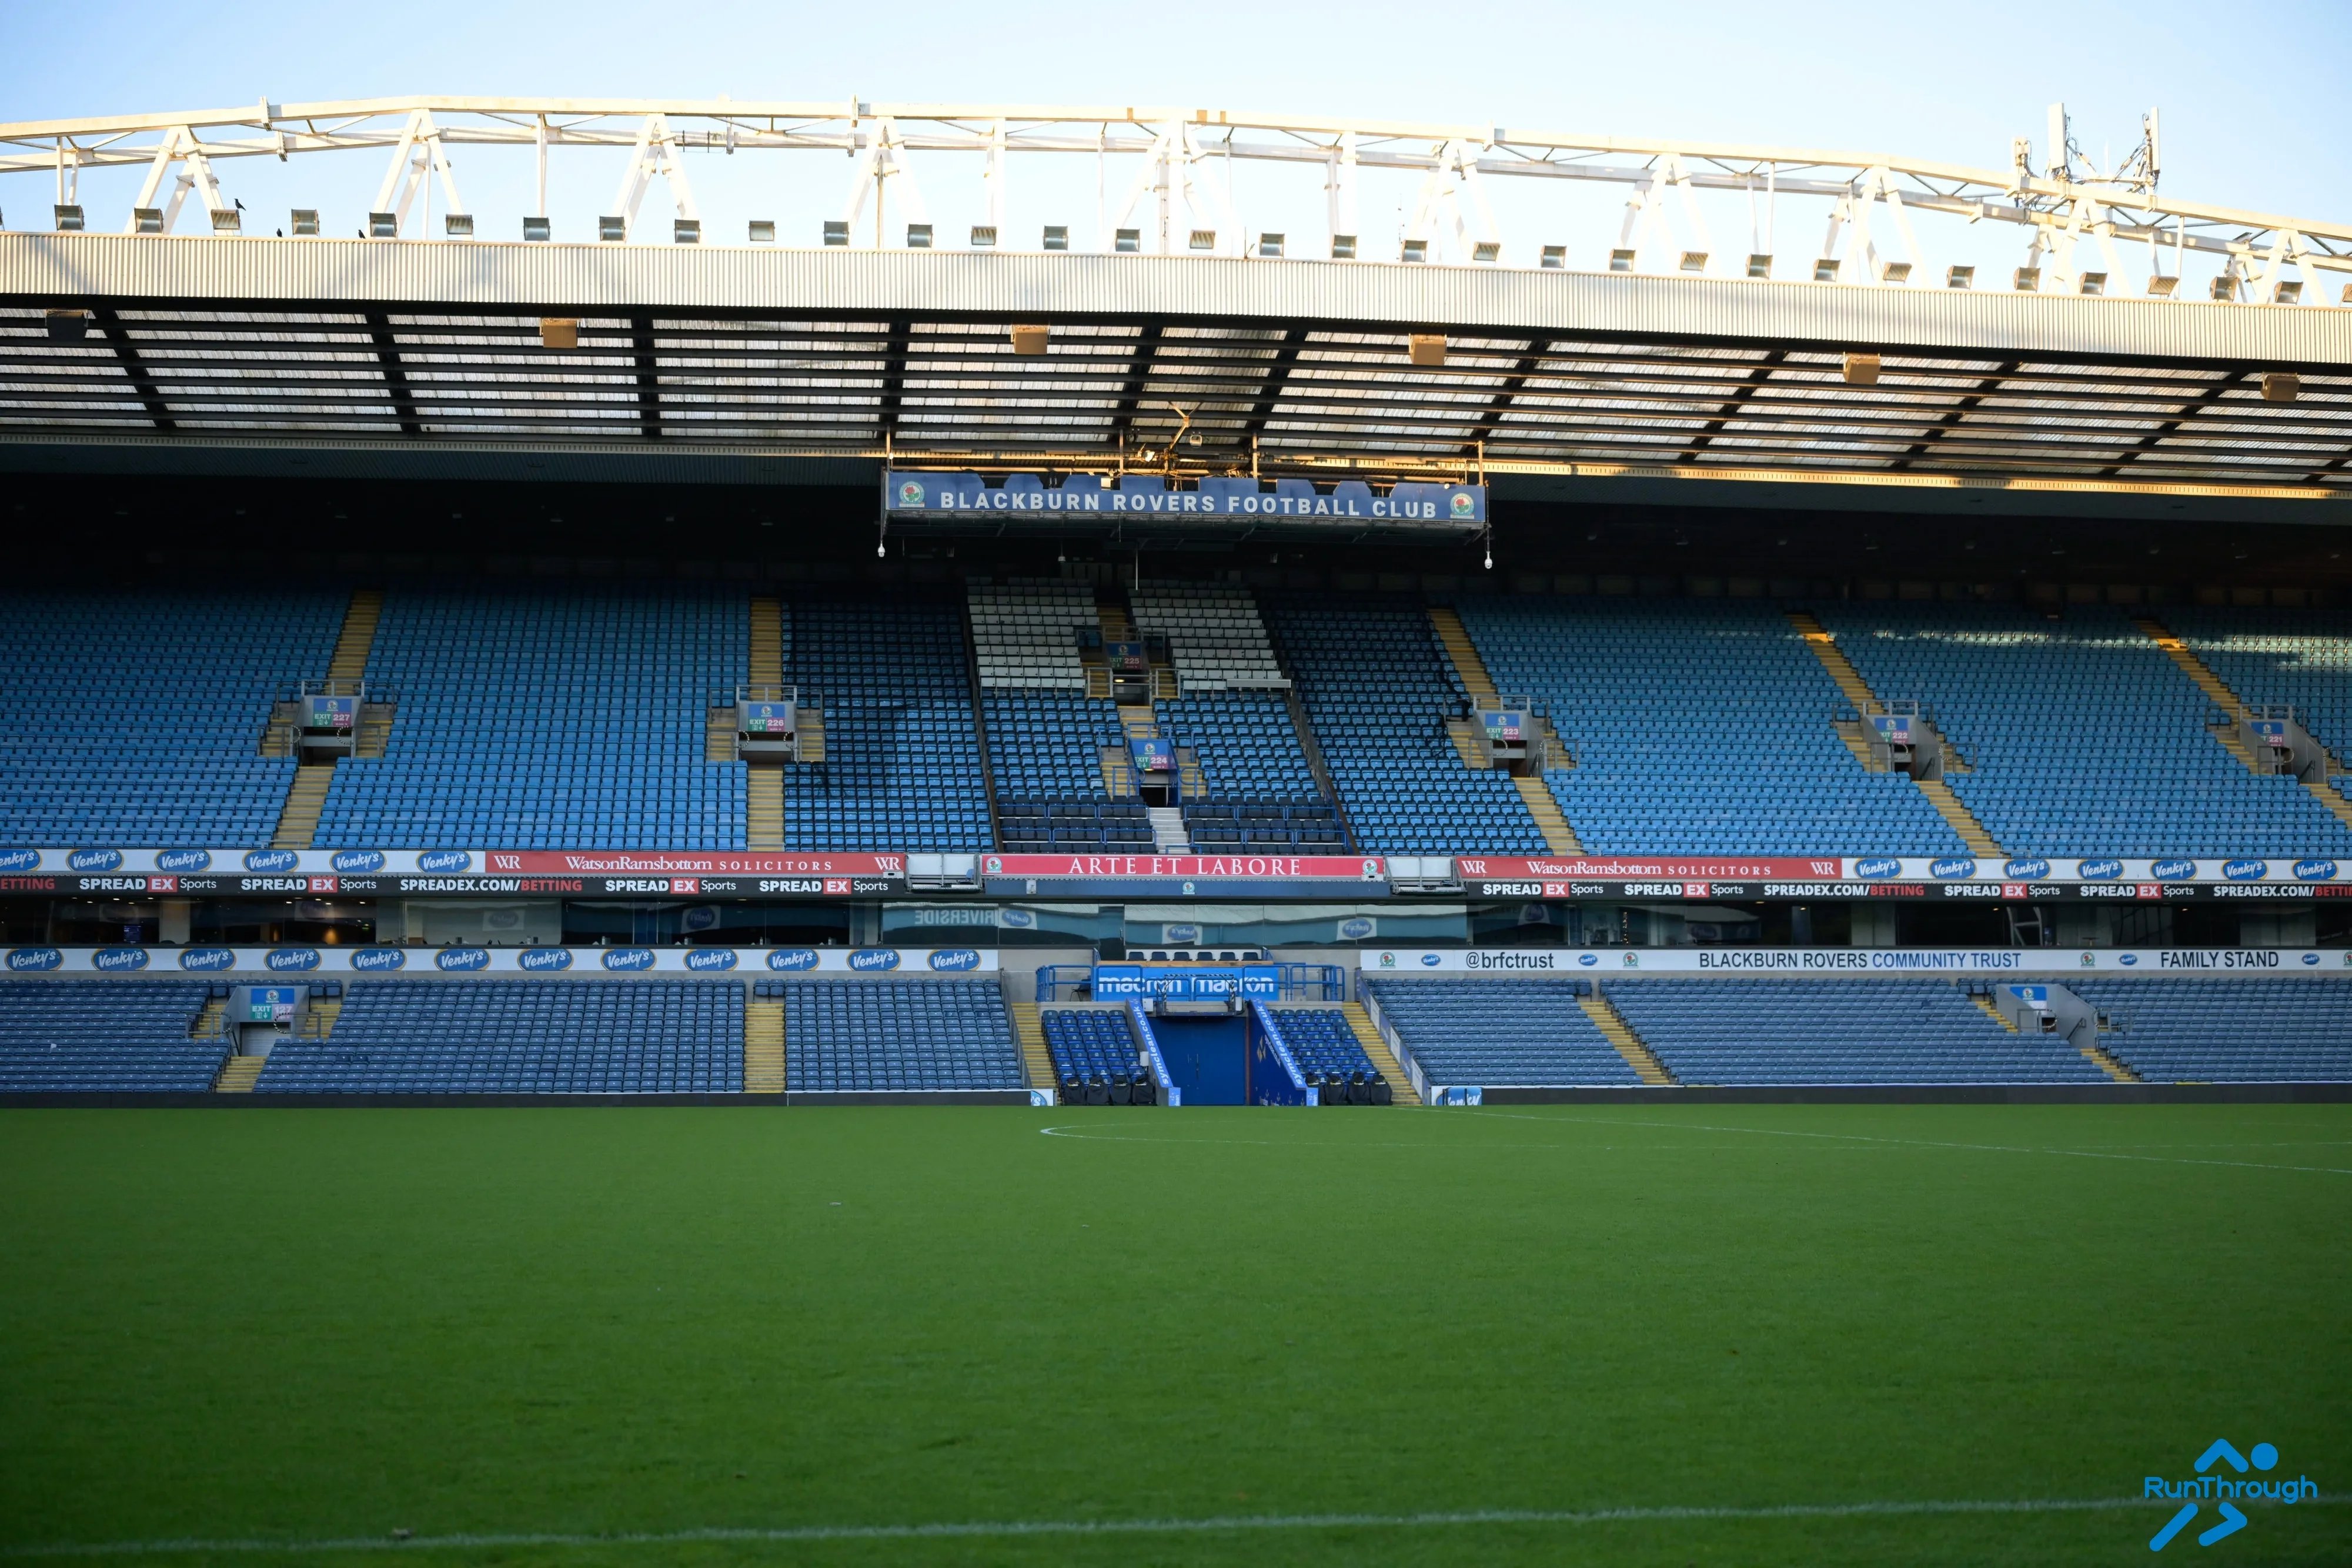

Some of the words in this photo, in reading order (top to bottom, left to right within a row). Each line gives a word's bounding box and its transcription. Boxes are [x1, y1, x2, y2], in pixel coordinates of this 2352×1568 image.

[941, 492, 1099, 510] BLACKBURN
[1113, 494, 1215, 512] ROVERS
[1228, 497, 1360, 516] FOOTBALL
[1372, 500, 1436, 519] CLUB
[0, 851, 35, 868] enky's
[74, 851, 116, 868] Venky's
[162, 851, 205, 868] Venky's
[249, 851, 292, 868] Venky's
[336, 851, 379, 869] Venky's
[423, 852, 465, 869] Venky's
[493, 855, 522, 869] WR
[565, 856, 712, 870] WatsonRamsbottom
[720, 861, 831, 871] SOLICITORS
[874, 857, 900, 870] WR
[1068, 857, 1137, 874] ARTE
[1151, 857, 1182, 874] ET
[1197, 858, 1301, 875] LABORE
[1462, 860, 1486, 874] WR
[1527, 861, 1662, 875] WatsonRamsbottom
[1668, 865, 1771, 875] SOLICITORS
[1810, 862, 1834, 875] WR
[1859, 861, 1896, 876] Venky's
[1935, 861, 1970, 876] Venky's
[2009, 861, 2044, 877] Venky's
[2083, 861, 2119, 877] Venky's
[2156, 861, 2191, 877] Venky's
[2227, 861, 2263, 877] Venky's
[2297, 861, 2332, 877] Venky's
[1, 878, 55, 890] ETTING
[181, 878, 216, 891] Sports
[340, 879, 376, 891] Sports
[701, 880, 736, 892] Sports
[854, 881, 888, 893] Sports
[1571, 884, 1603, 895] Sports
[1712, 884, 1743, 896] Sports
[2029, 885, 2060, 897] Sports
[2163, 885, 2194, 897] Sports
[13, 952, 55, 967] Venky's
[99, 952, 142, 967] Venky's
[186, 952, 228, 967] Venky's
[272, 952, 313, 967] Venky's
[358, 952, 399, 967] Venky's
[442, 951, 483, 967] Venky's
[525, 952, 566, 967] Venky's
[609, 952, 649, 967] Venky's
[691, 952, 731, 967] Venky's
[773, 952, 813, 967] Venky's
[854, 952, 894, 968] Venky's
[934, 952, 974, 968] Venky's
[1465, 951, 1554, 968] @brfctrust
[1699, 952, 1798, 967] BLACKBURN
[1803, 952, 1867, 967] ROVERS
[1872, 952, 1967, 967] COMMUNITY
[1970, 952, 2022, 967] TRUST
[2161, 951, 2221, 967] FAMILY
[2224, 951, 2279, 967] STAND
[1098, 977, 1182, 992] macron
[1191, 977, 1274, 992] macron
[275, 1005, 292, 1014] 127
